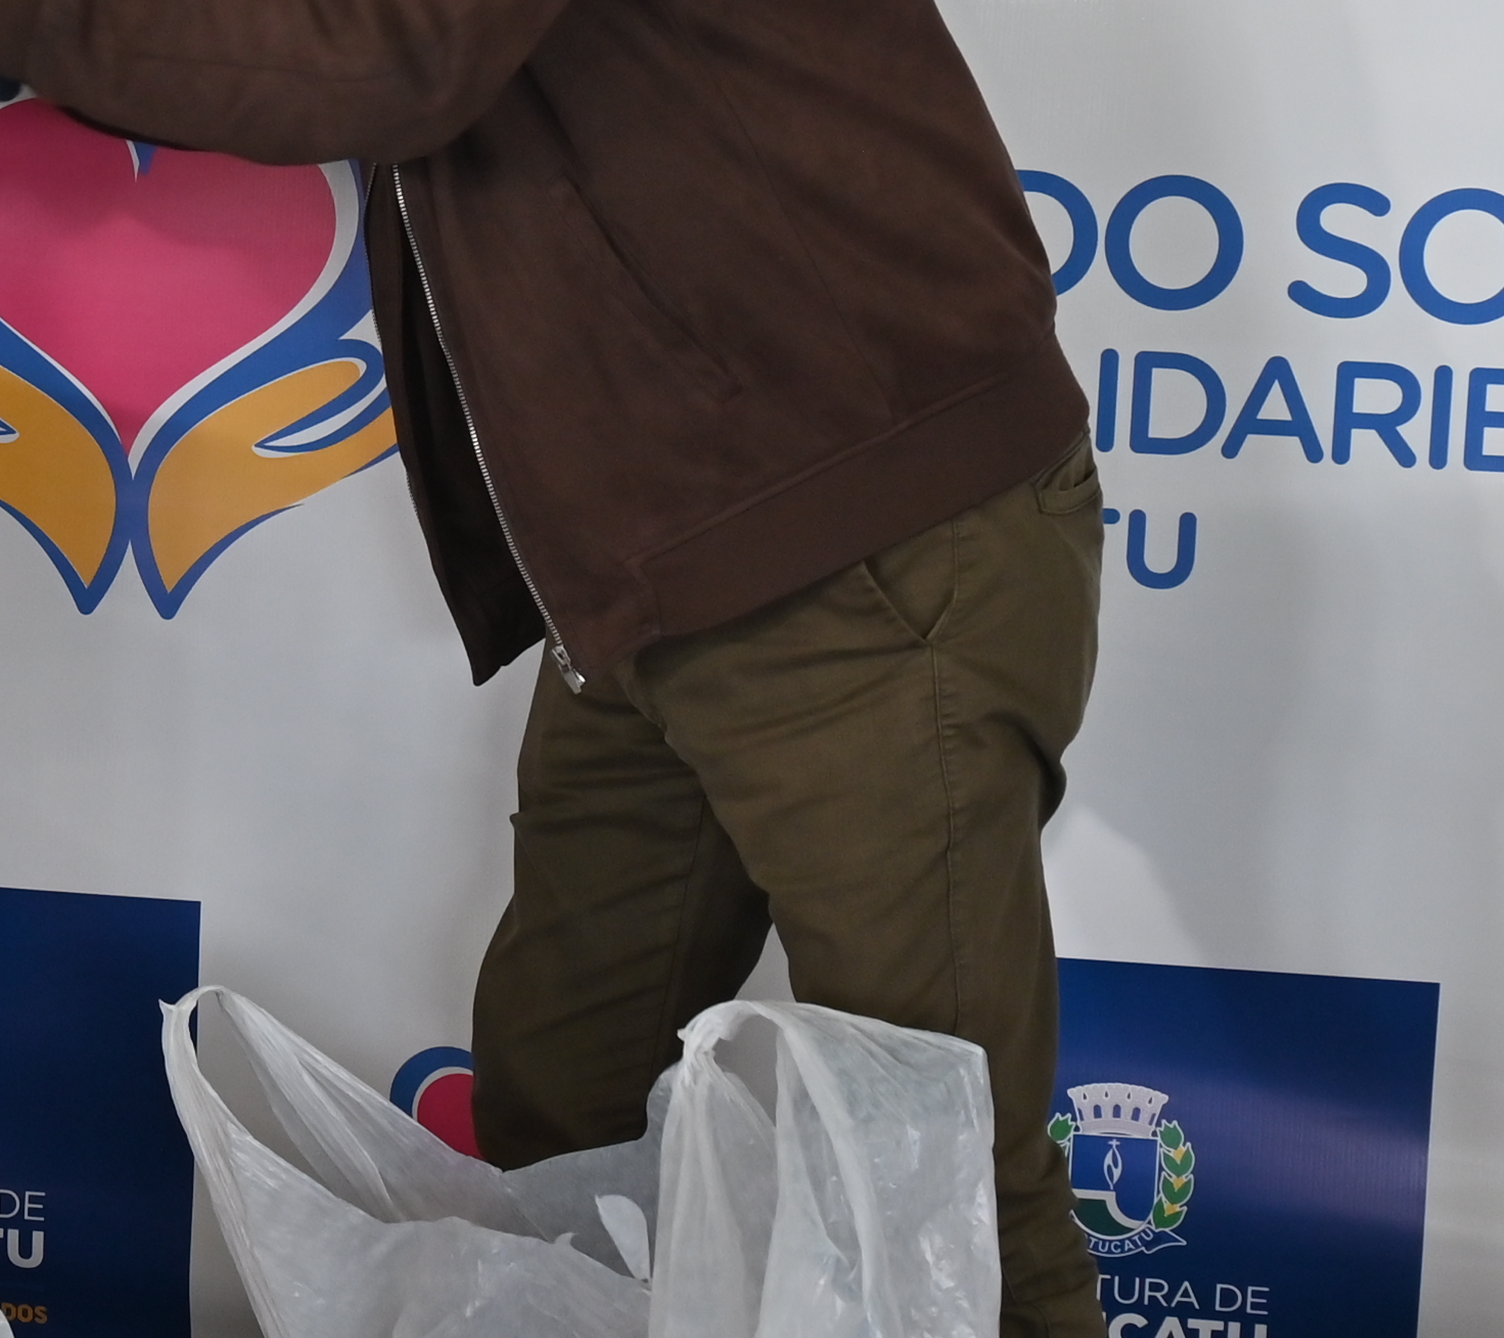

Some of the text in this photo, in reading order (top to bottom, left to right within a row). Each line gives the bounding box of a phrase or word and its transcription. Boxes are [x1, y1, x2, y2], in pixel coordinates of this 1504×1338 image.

[1085, 1227, 1155, 1254] TUCATU
[1214, 1282, 1271, 1316] DE
[0, 1301, 49, 1325] DOS
